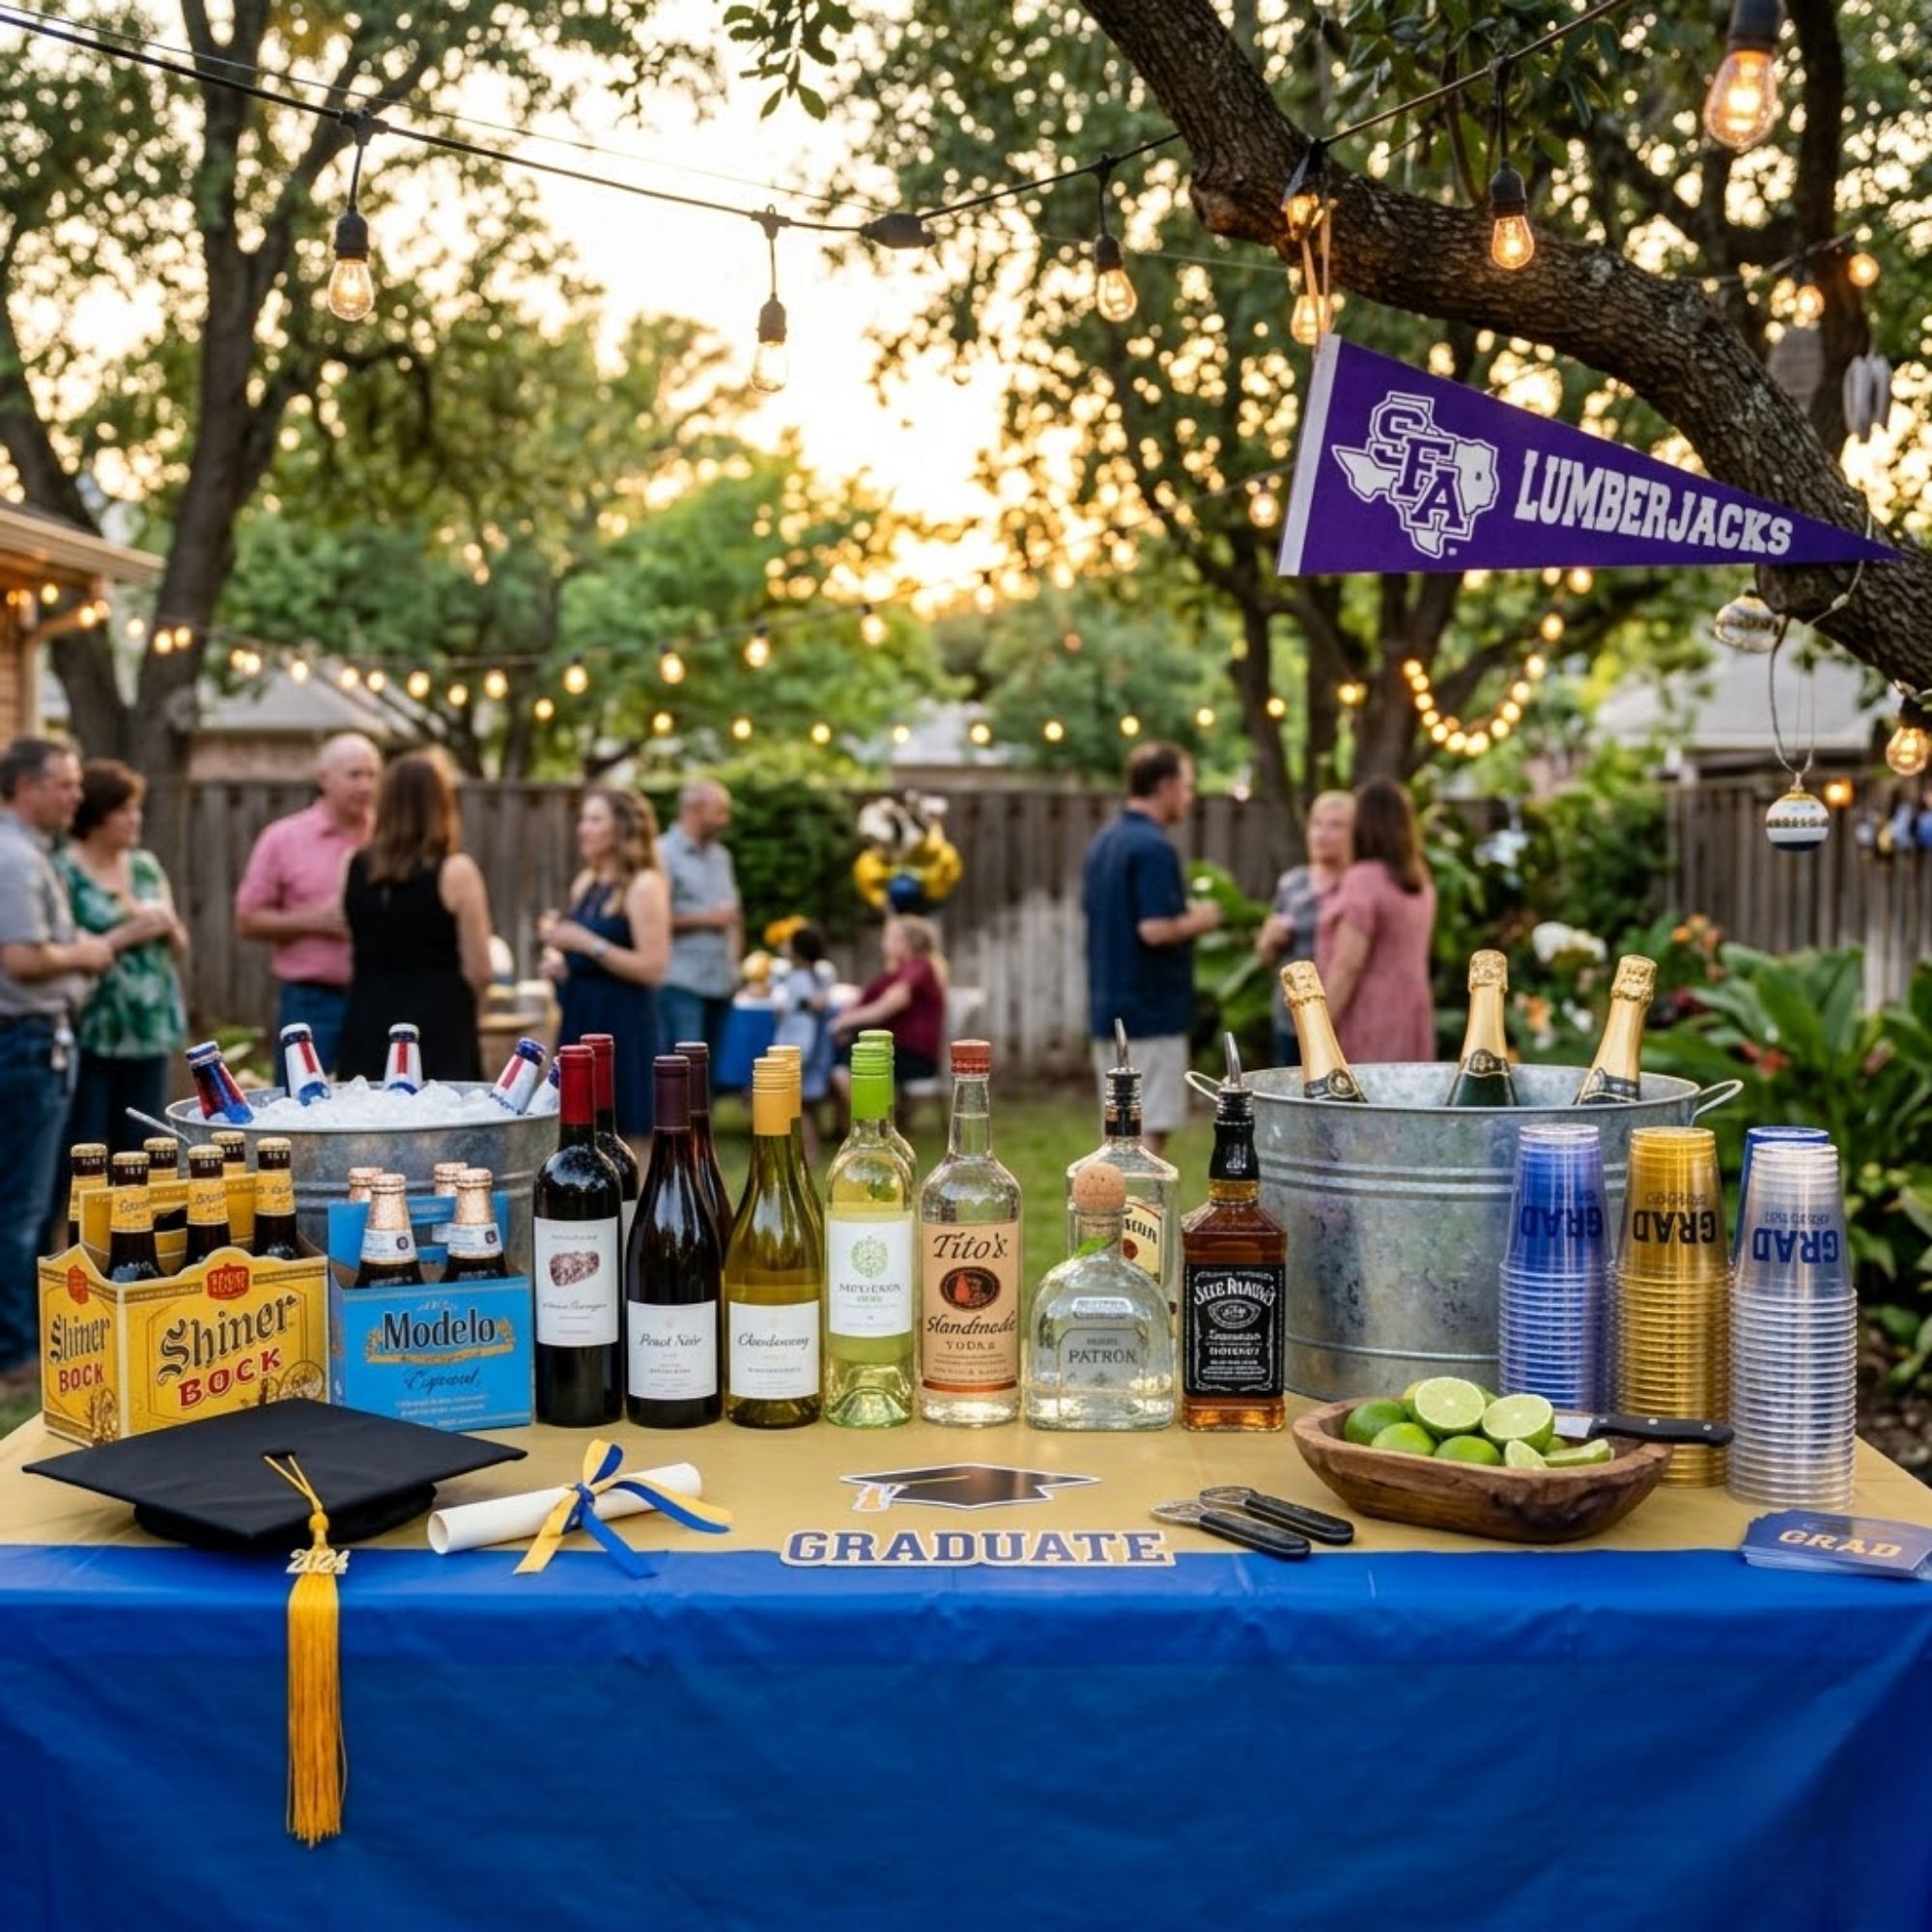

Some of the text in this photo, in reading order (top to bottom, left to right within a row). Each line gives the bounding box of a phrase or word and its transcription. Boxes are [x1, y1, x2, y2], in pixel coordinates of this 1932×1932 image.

[1367, 390, 1471, 541] SFA
[1514, 449, 1793, 555] LUMBERJACKS
[1520, 1204, 1605, 1238] GRAD
[1633, 1209, 1717, 1244] GRAD
[933, 1232, 1009, 1260] Tito's
[1752, 1227, 1839, 1264] GRAD
[49, 1314, 110, 1364] Shiner
[156, 1294, 299, 1386] Shiner
[384, 1308, 496, 1350] Modelo
[58, 1363, 104, 1393] BOCK
[178, 1347, 282, 1409] BOCK
[785, 1531, 1169, 1563] GRADUATE
[1778, 1529, 1903, 1558] GRAD
